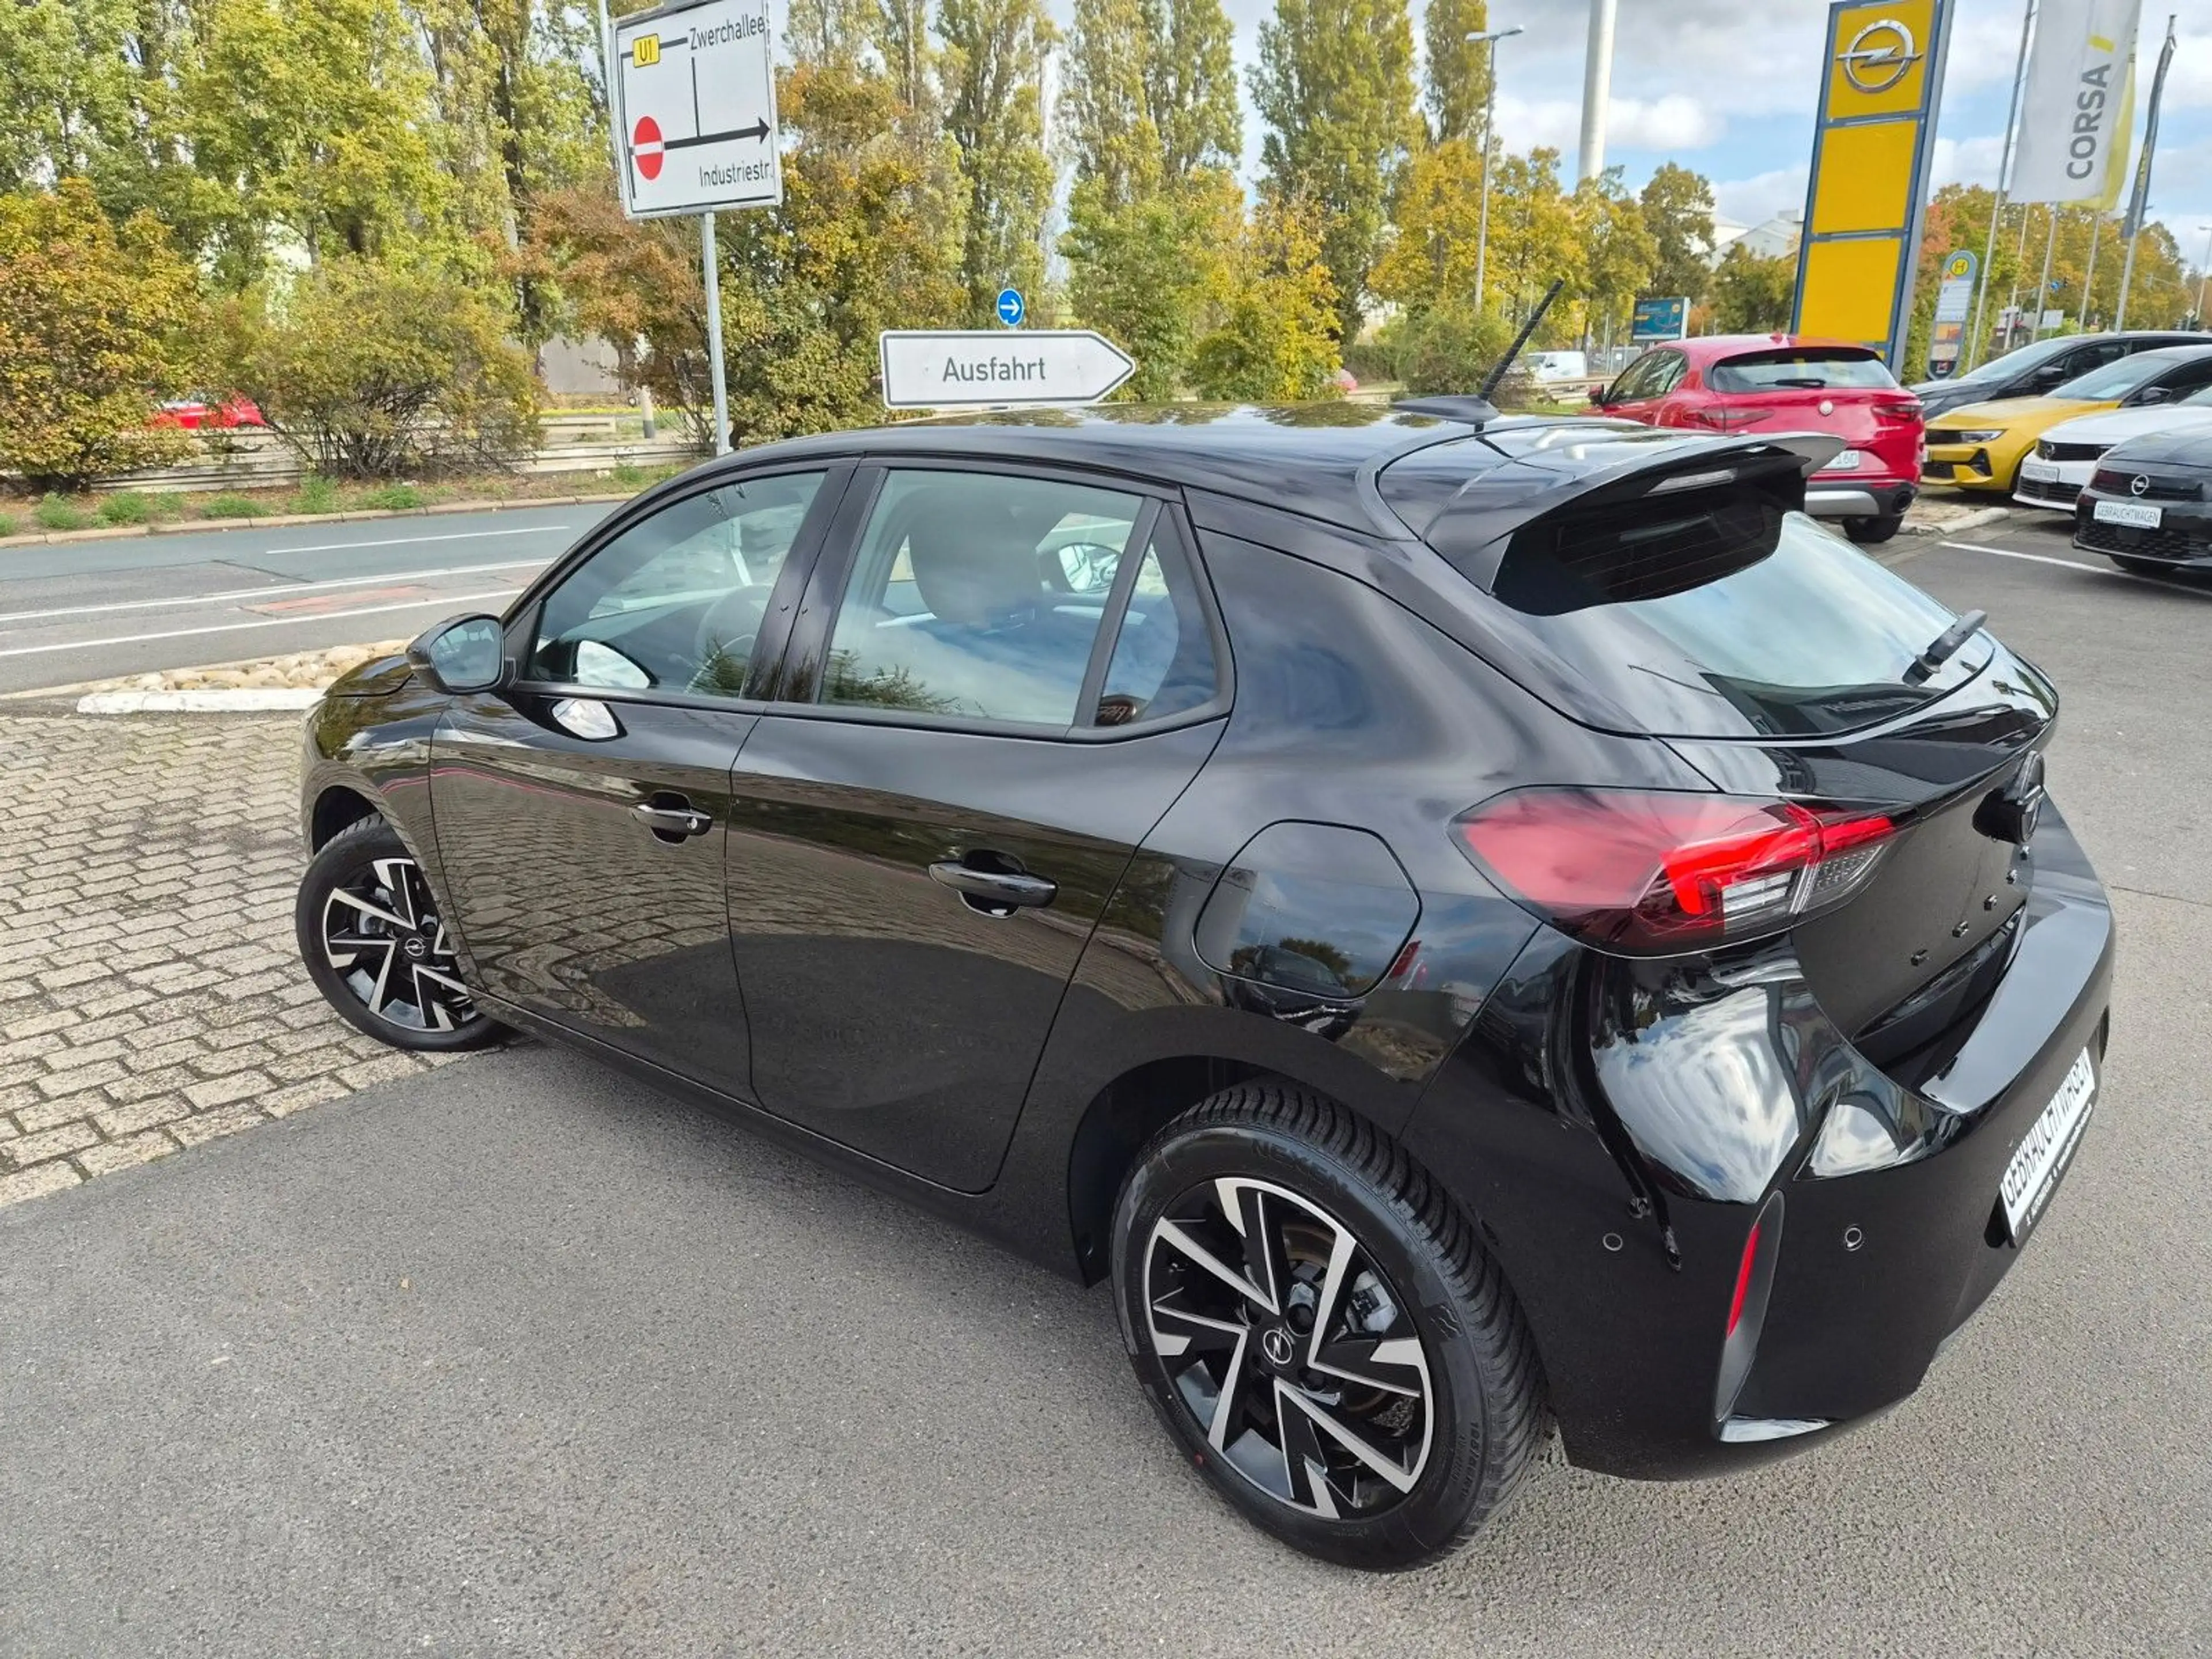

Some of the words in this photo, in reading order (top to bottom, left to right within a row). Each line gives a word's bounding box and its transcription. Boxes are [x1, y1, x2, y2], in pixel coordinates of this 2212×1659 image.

[689, 14, 766, 51] Zwerchallee
[2066, 63, 2111, 180] CORSA
[942, 355, 1046, 382] Ausfahrt
